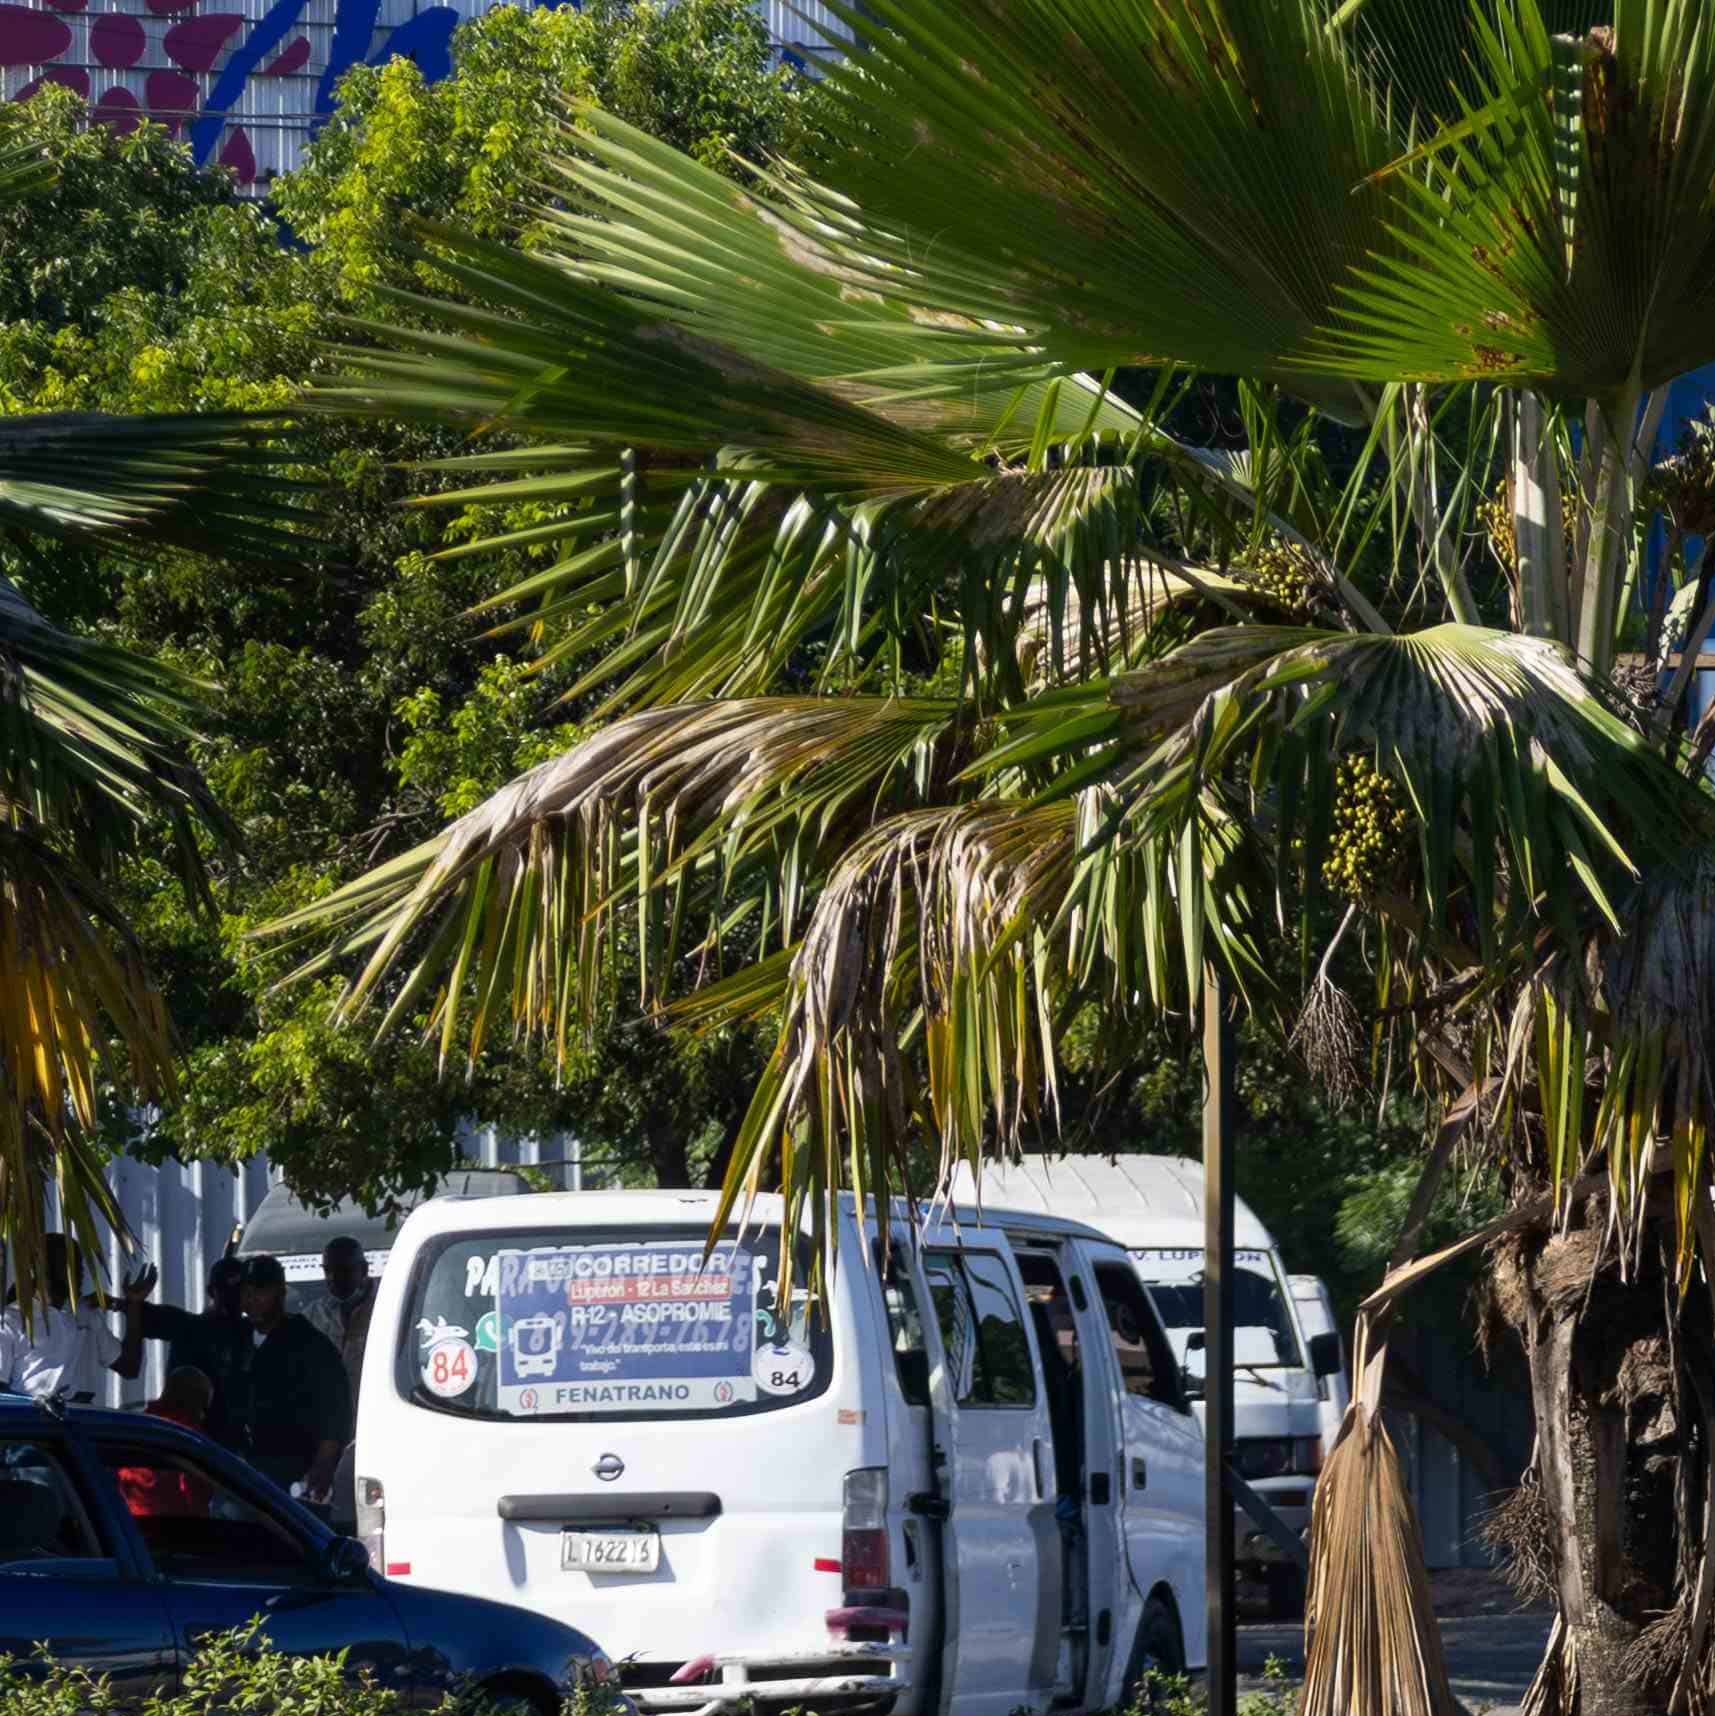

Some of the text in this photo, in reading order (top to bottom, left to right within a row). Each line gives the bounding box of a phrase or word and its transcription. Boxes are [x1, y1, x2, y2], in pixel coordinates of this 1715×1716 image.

[575, 1253, 727, 1278] CORREDOR
[1160, 1250, 1262, 1262] LUPON
[621, 1302, 732, 1322] ASOPROMIE
[433, 1345, 469, 1385] 84
[771, 1371, 801, 1388] 84
[556, 1385, 690, 1404] FENATRANO
